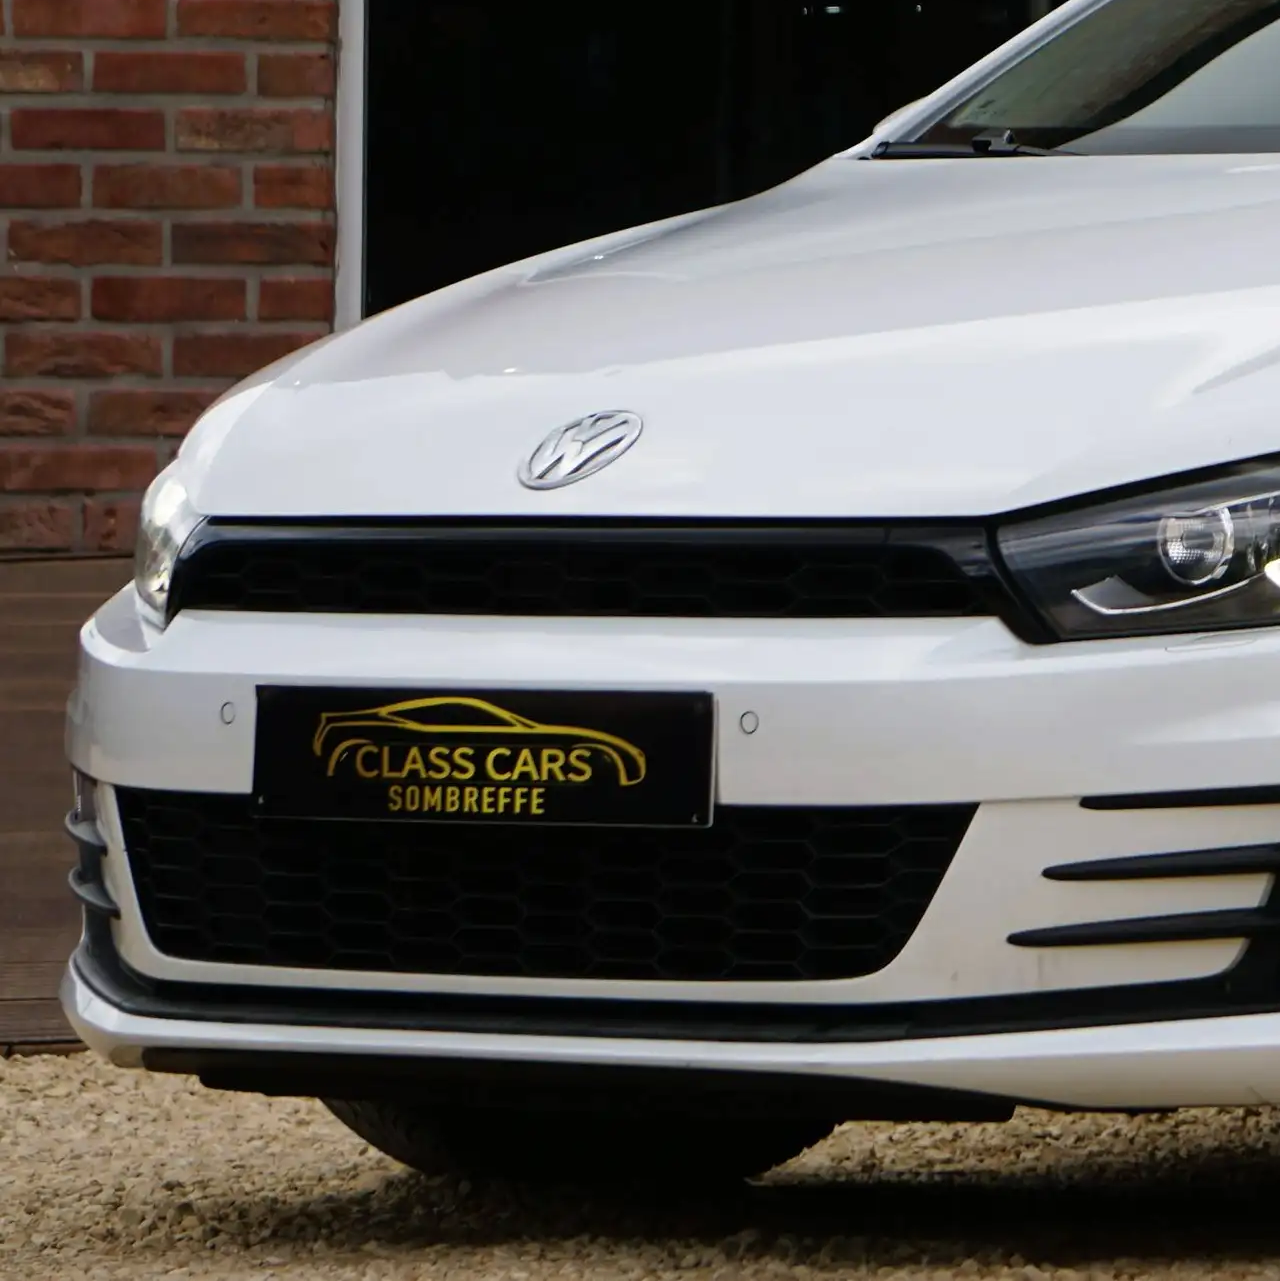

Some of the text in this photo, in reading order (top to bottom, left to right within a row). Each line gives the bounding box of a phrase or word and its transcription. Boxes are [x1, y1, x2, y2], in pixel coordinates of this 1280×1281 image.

[355, 745, 593, 782] CLASS CARS
[388, 784, 546, 815] SOMBREFFE
